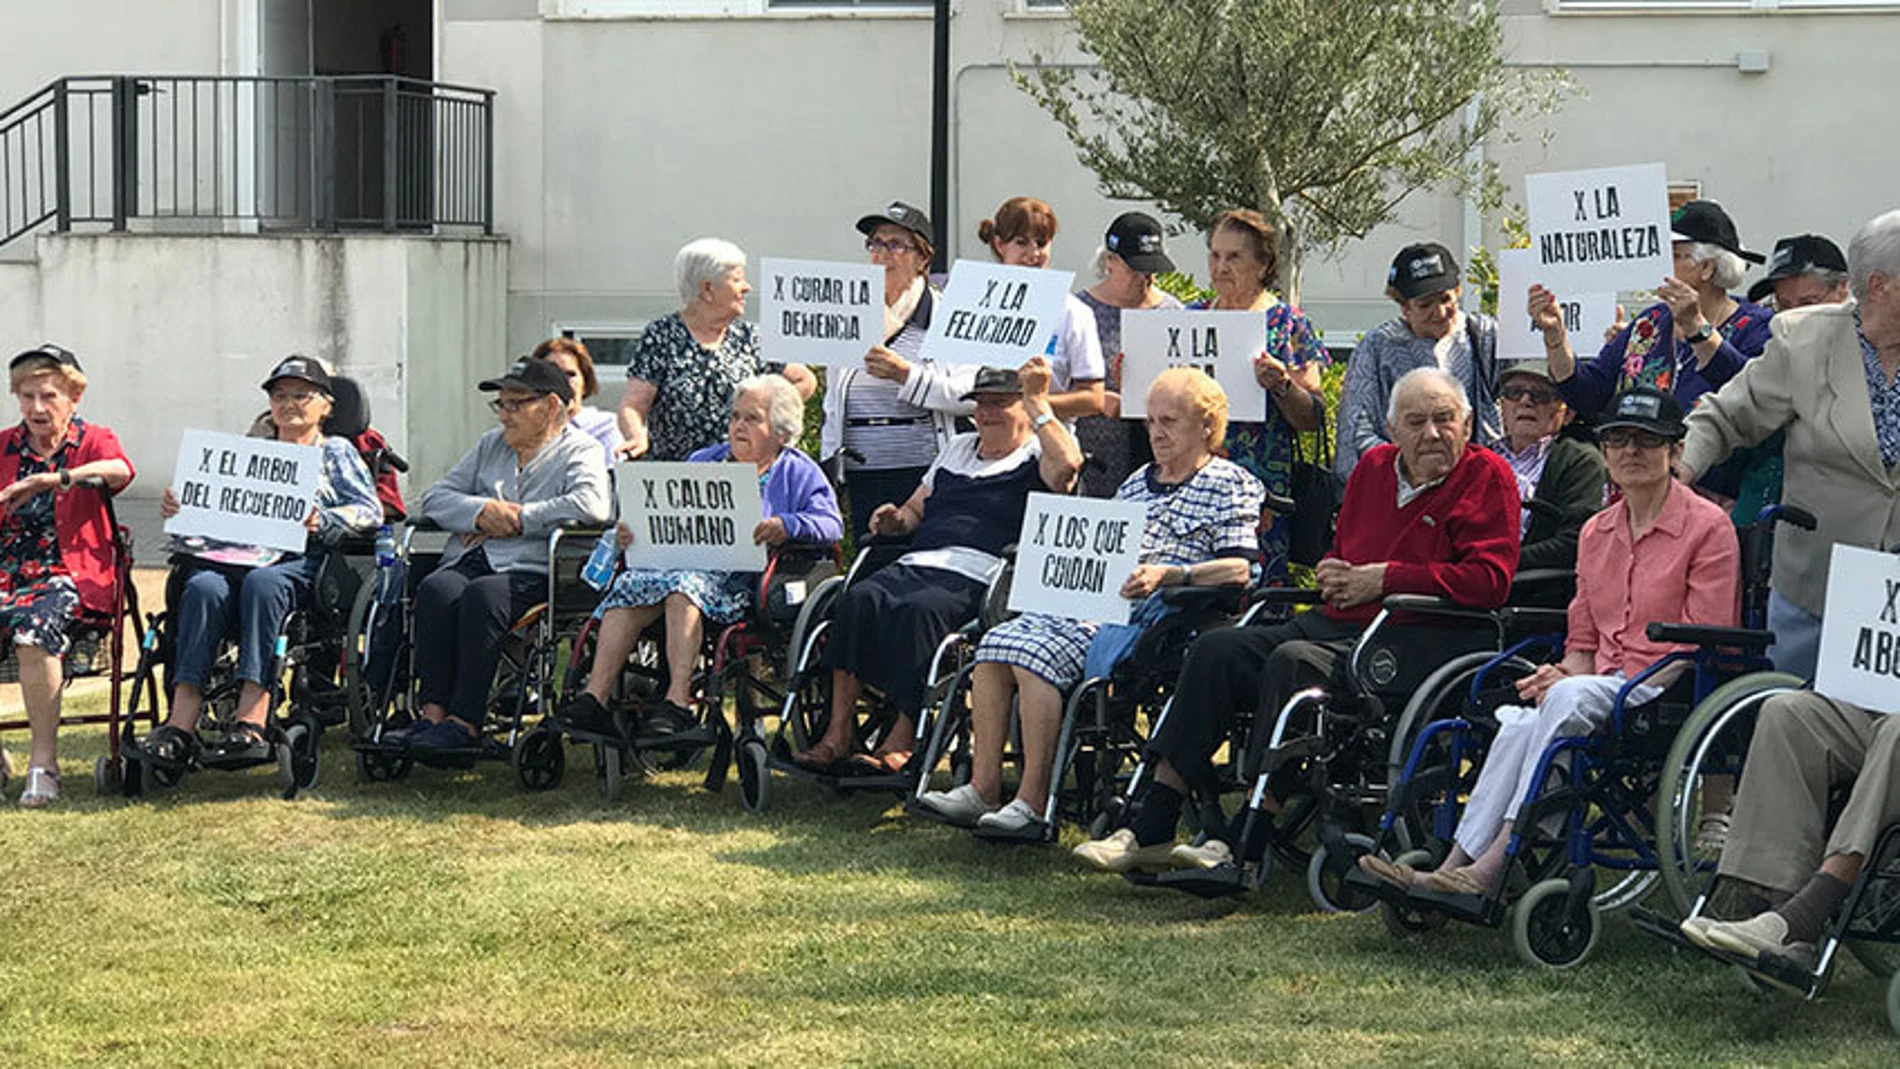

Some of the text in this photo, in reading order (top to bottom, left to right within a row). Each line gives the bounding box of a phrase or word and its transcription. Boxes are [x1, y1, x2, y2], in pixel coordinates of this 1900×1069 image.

[1574, 186, 1621, 221] X LA
[1540, 225, 1661, 265] NATURALEZA
[774, 275, 870, 305] X CURAR LA
[978, 279, 1028, 311] X LA
[782, 311, 860, 341] DEMENCIA
[944, 310, 1037, 348] FELICIDAD
[1530, 302, 1581, 333] OR
[1167, 327, 1219, 357] X LA
[199, 448, 300, 486] X EL ARBOL
[181, 481, 306, 523] DEL RECUERDO
[642, 478, 735, 510] X CALOR
[649, 515, 736, 546] HUMANO
[1033, 512, 1130, 556] X LOS QUE
[1041, 553, 1107, 593] CUIDAN
[1880, 578, 1900, 624] X
